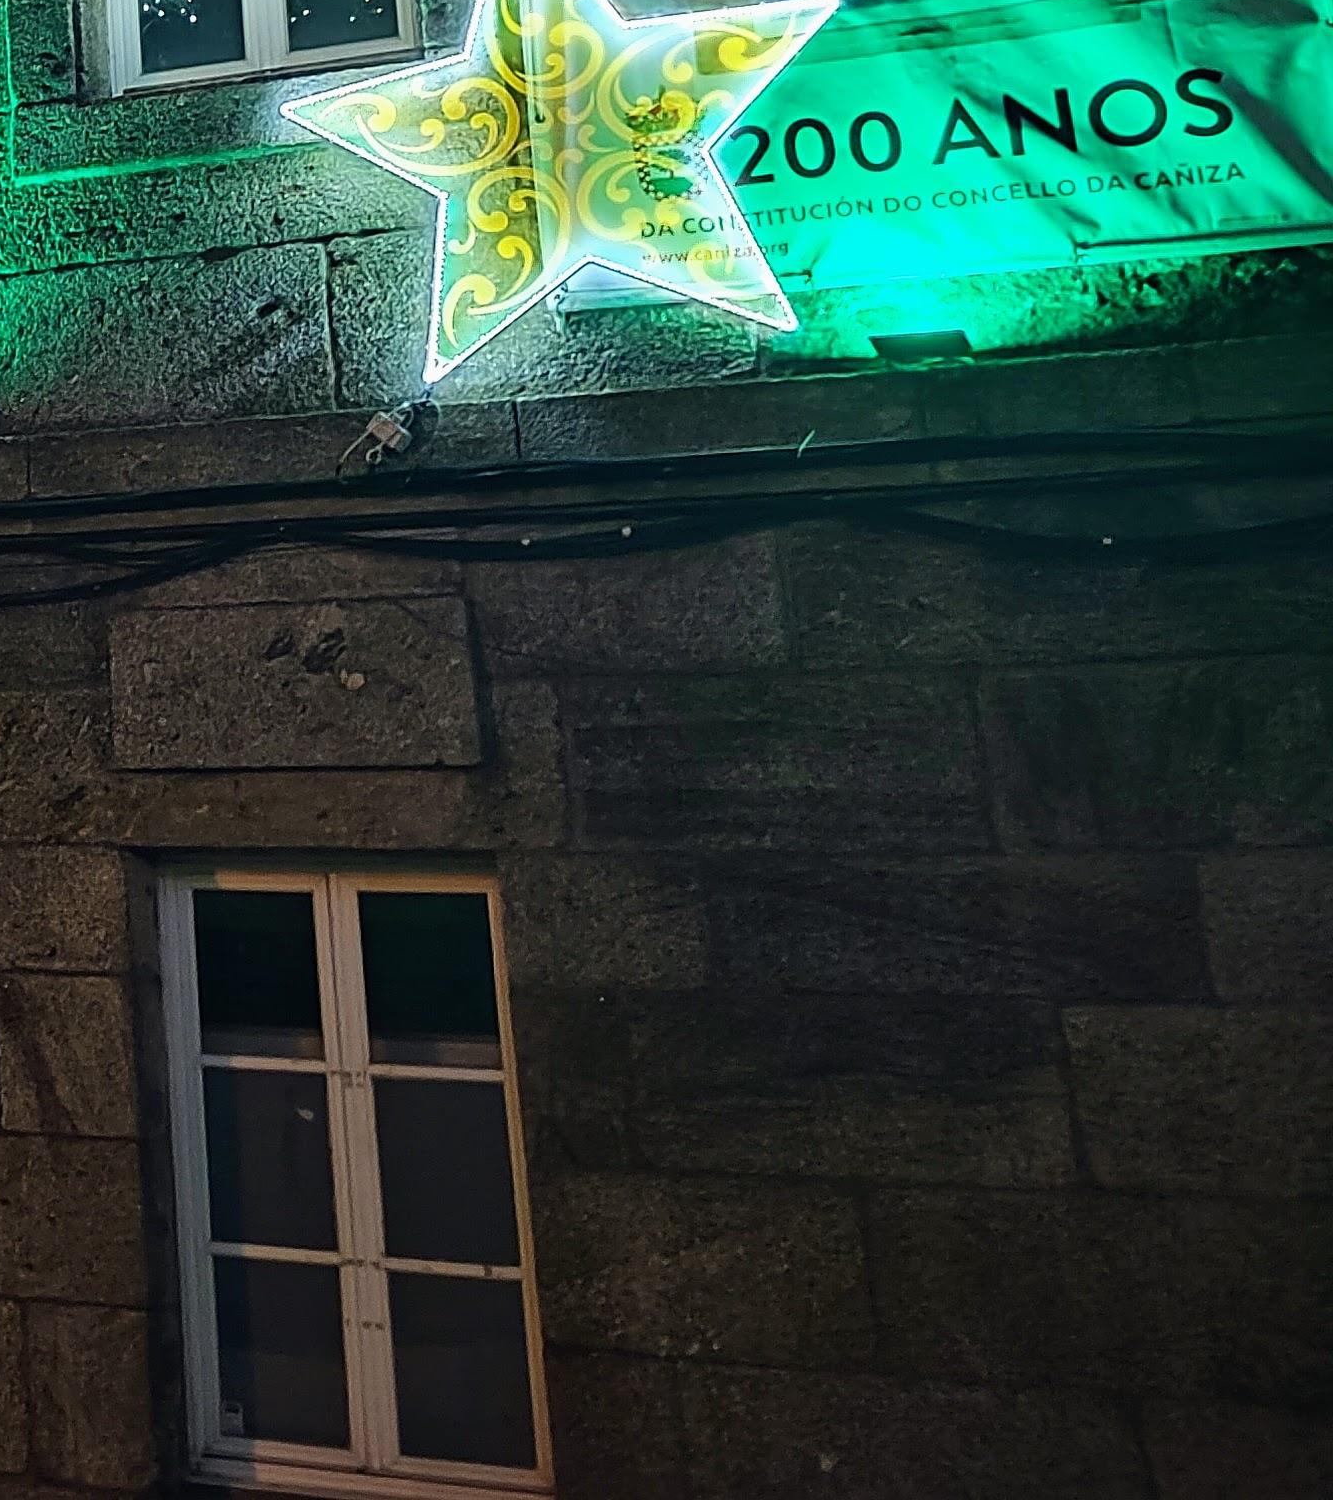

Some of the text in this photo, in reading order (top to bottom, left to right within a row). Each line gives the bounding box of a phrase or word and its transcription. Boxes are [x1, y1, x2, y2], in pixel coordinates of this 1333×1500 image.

[729, 68, 1233, 188] 200 ANOS
[884, 195, 922, 214] DO
[932, 178, 1076, 209] CONCELLO
[1086, 175, 1126, 193] DA
[1134, 161, 1246, 191] CAÑIZA
